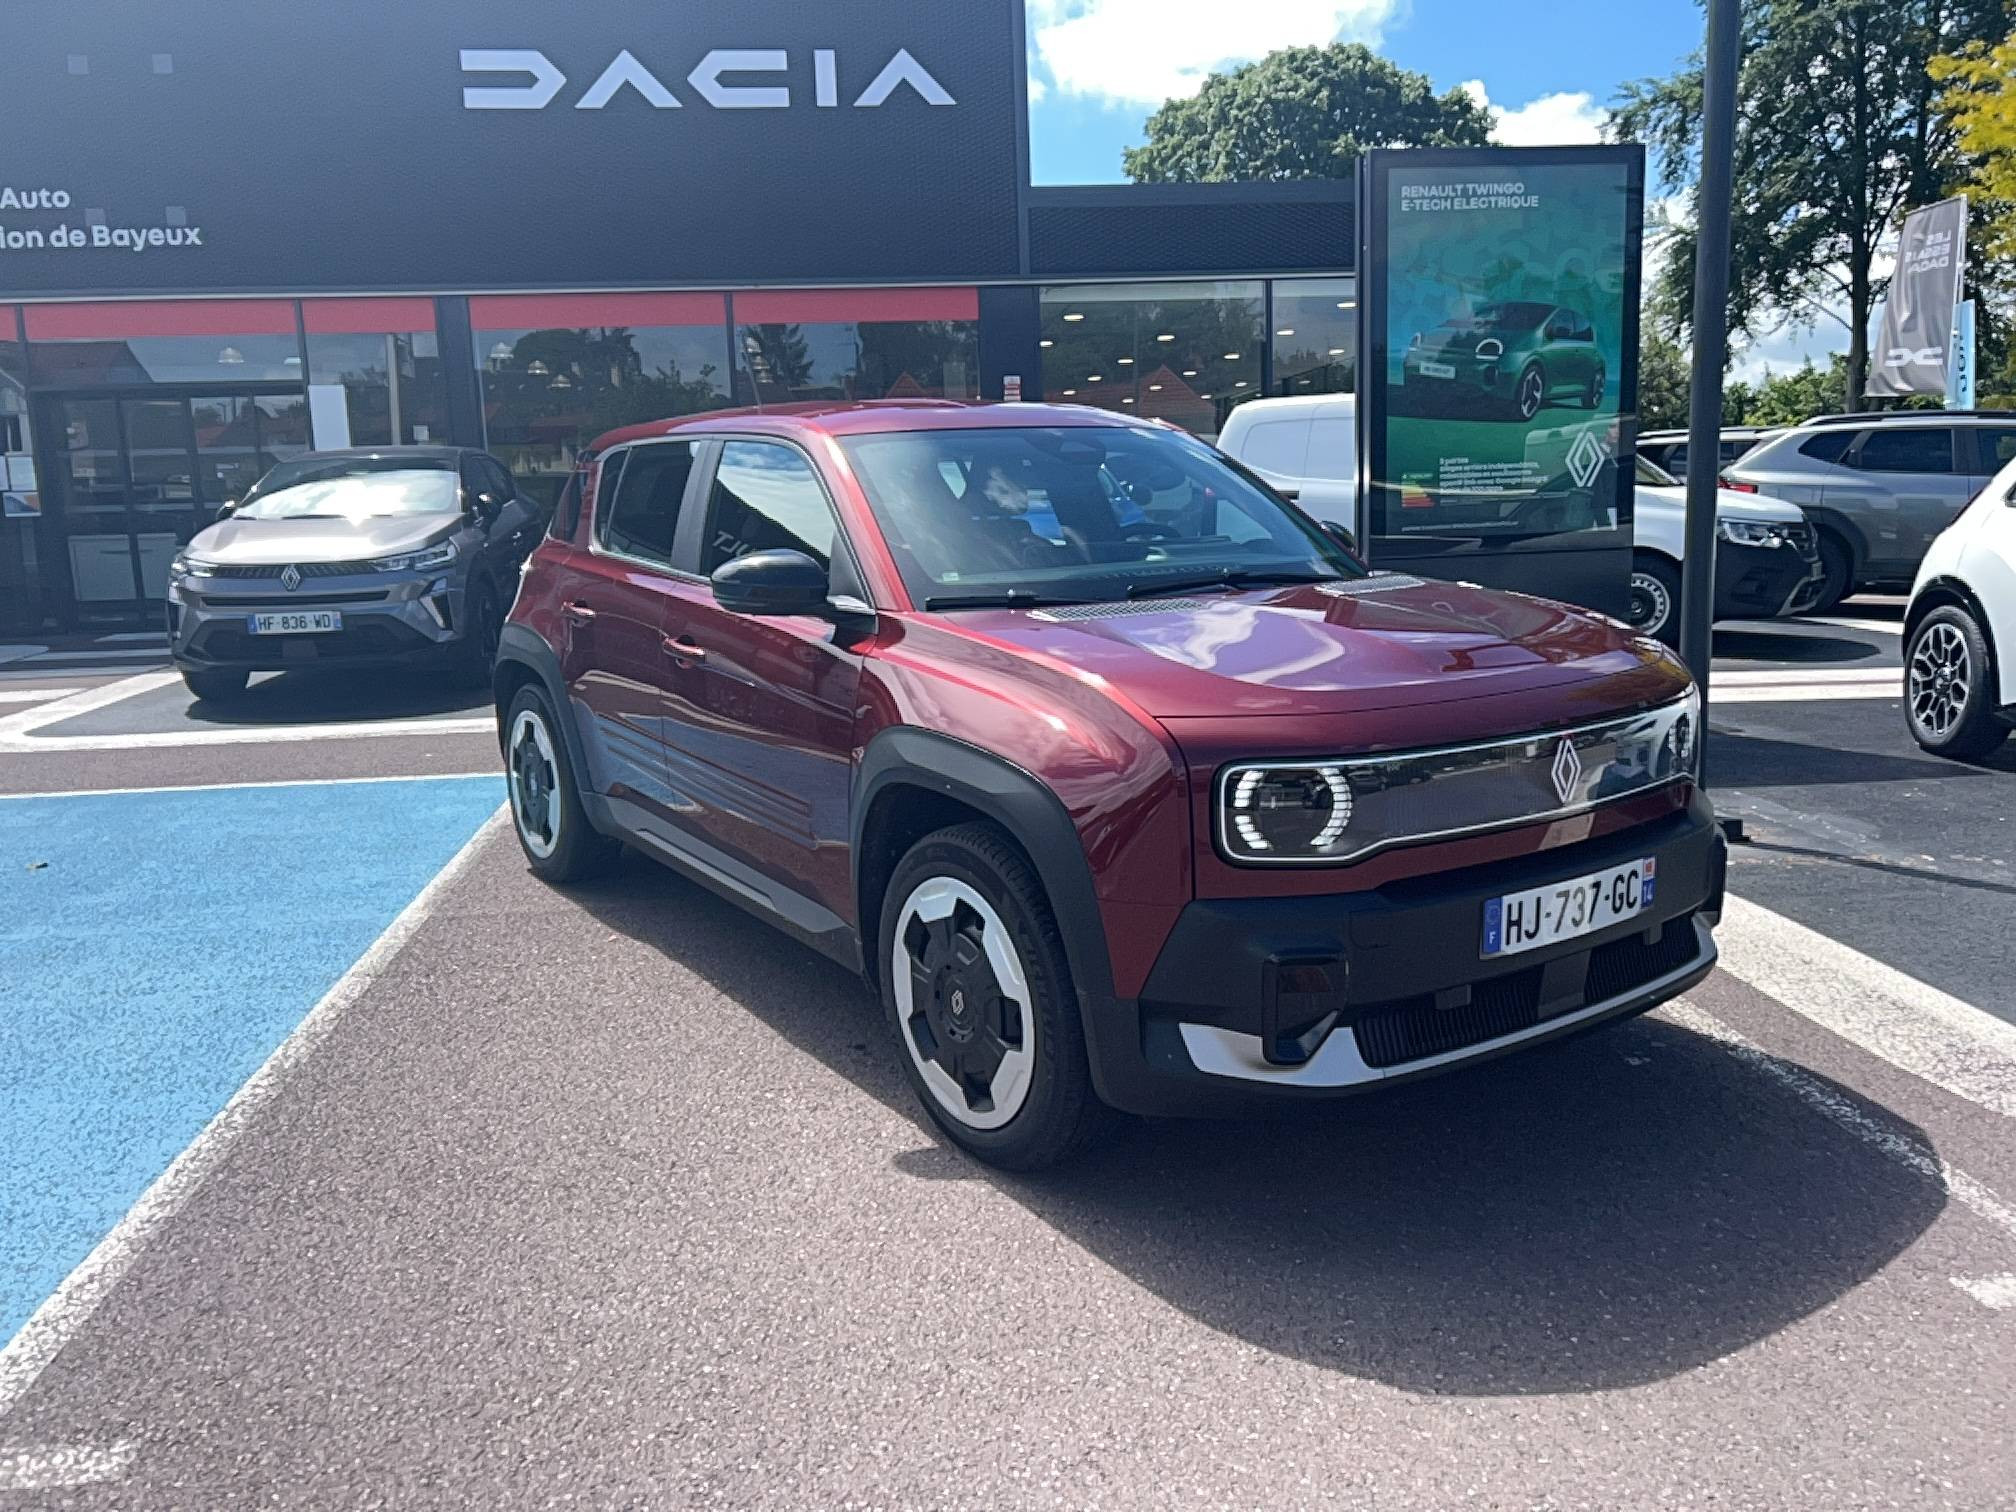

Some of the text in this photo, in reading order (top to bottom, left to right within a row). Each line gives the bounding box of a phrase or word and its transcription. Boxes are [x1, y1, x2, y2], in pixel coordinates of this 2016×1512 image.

[459, 48, 957, 109] DACIA
[0, 187, 71, 209] Auto
[1401, 182, 1525, 198] RENAULT TWINGO
[1401, 198, 1451, 212] E-TECH
[50, 224, 86, 248] de
[91, 224, 202, 251] Bayeux
[1505, 869, 1639, 946] HJ-737-GC
